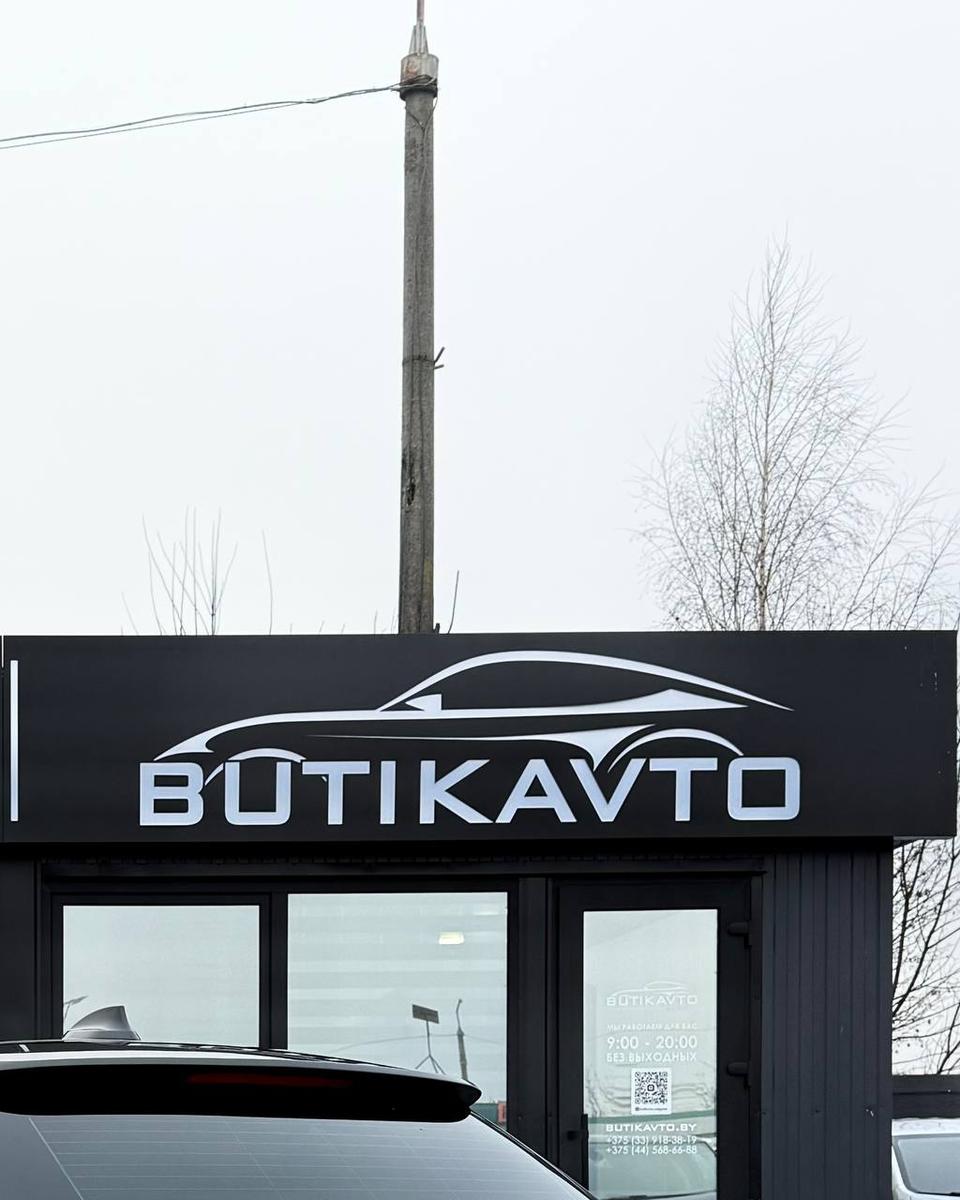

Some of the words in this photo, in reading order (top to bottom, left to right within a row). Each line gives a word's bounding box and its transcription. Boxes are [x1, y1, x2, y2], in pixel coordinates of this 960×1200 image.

[139, 757, 801, 826] BUTIKAVTO
[606, 995, 698, 1006] BUTIKAVTO
[607, 1036, 639, 1049] 9:00
[655, 1035, 697, 1049] 20:00
[607, 1052, 625, 1062] БЕЗ
[628, 1052, 697, 1062] ВЫХОДНЫХ
[606, 1123, 697, 1132] BUTIKAVTO.BY
[607, 1135, 629, 1144] +375
[631, 1135, 649, 1146] (33)
[652, 1135, 697, 1144] 918-38-19
[607, 1146, 629, 1155] +375
[631, 1146, 649, 1156] (44)
[652, 1145, 697, 1155] 568-66-88
